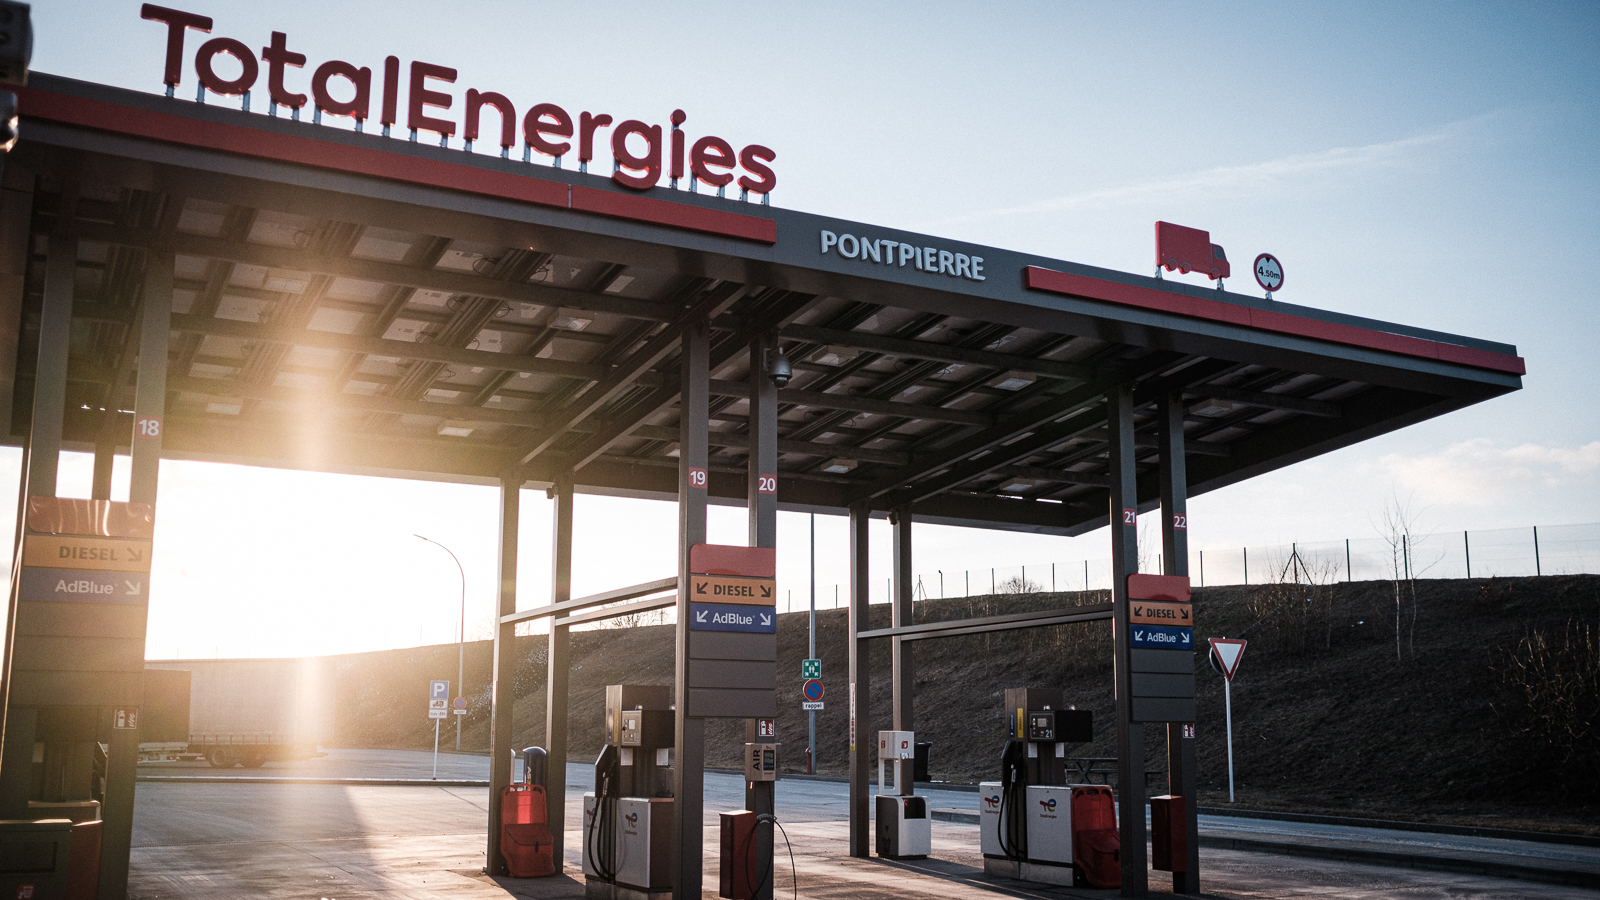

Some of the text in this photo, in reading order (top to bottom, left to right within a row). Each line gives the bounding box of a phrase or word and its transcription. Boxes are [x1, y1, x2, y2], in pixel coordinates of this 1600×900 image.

[140, 3, 777, 190] TotalEnergies
[820, 229, 986, 281] PONTPIERRE
[1258, 266, 1280, 279] 4.50m
[138, 419, 160, 436] 18
[690, 470, 706, 486] 19
[758, 477, 776, 492] 20
[1124, 511, 1136, 524] 21
[1174, 515, 1187, 528] 22
[58, 545, 118, 562] DIESEL
[54, 579, 115, 595] AdBlue
[713, 584, 755, 598] DIESEL
[712, 612, 753, 625] AdBlue
[1146, 608, 1177, 619] DIESEL
[1146, 632, 1177, 643] AdBlue
[433, 682, 446, 697] P
[1045, 729, 1053, 738] 21
[753, 749, 761, 771] AIR
